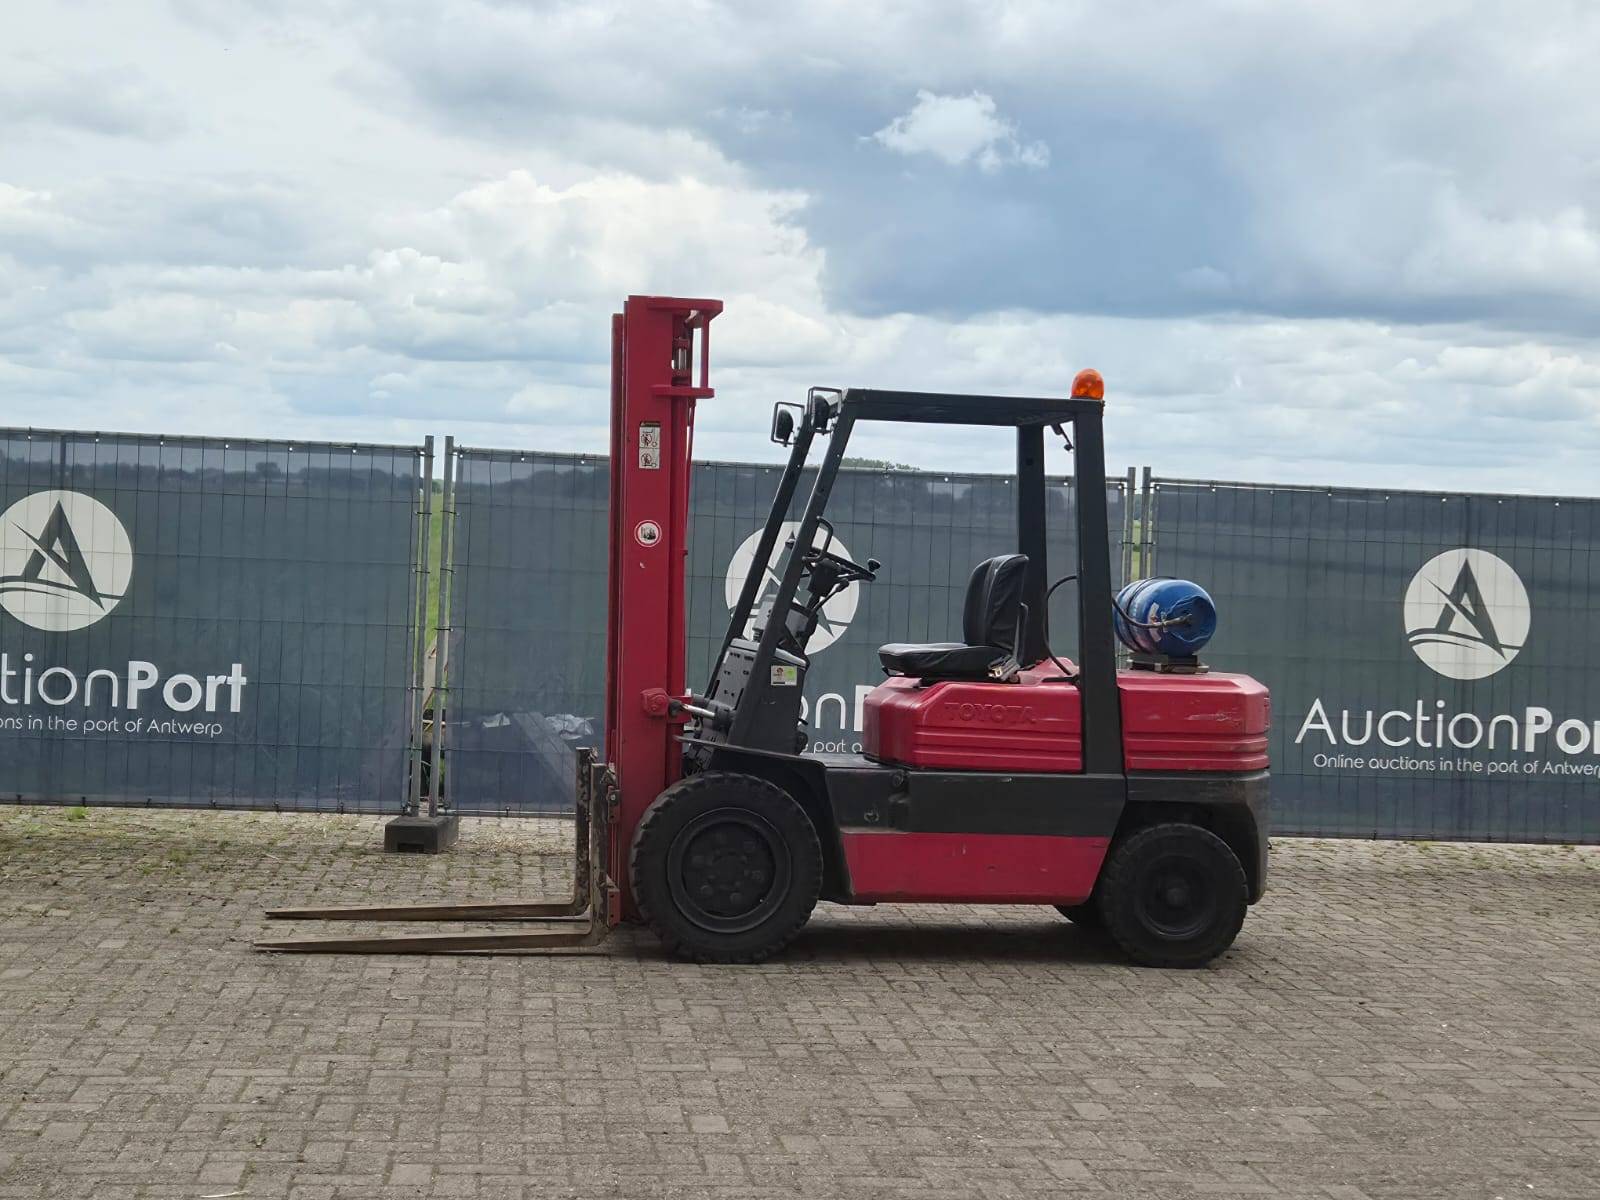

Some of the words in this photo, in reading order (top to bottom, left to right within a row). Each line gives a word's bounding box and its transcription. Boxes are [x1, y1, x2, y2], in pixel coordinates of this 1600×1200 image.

[944, 702, 1037, 725] TOYOTA
[28, 715, 43, 731] in
[48, 716, 78, 731] the
[83, 717, 120, 735] port
[124, 718, 143, 733] of
[147, 719, 223, 738] Antwerp
[813, 739, 847, 754] port
[1313, 753, 1364, 769] Online
[1368, 756, 1436, 771] auctions
[1440, 757, 1453, 771] in
[1457, 758, 1483, 772] the
[1487, 760, 1519, 775] port
[1523, 760, 1538, 774] of
